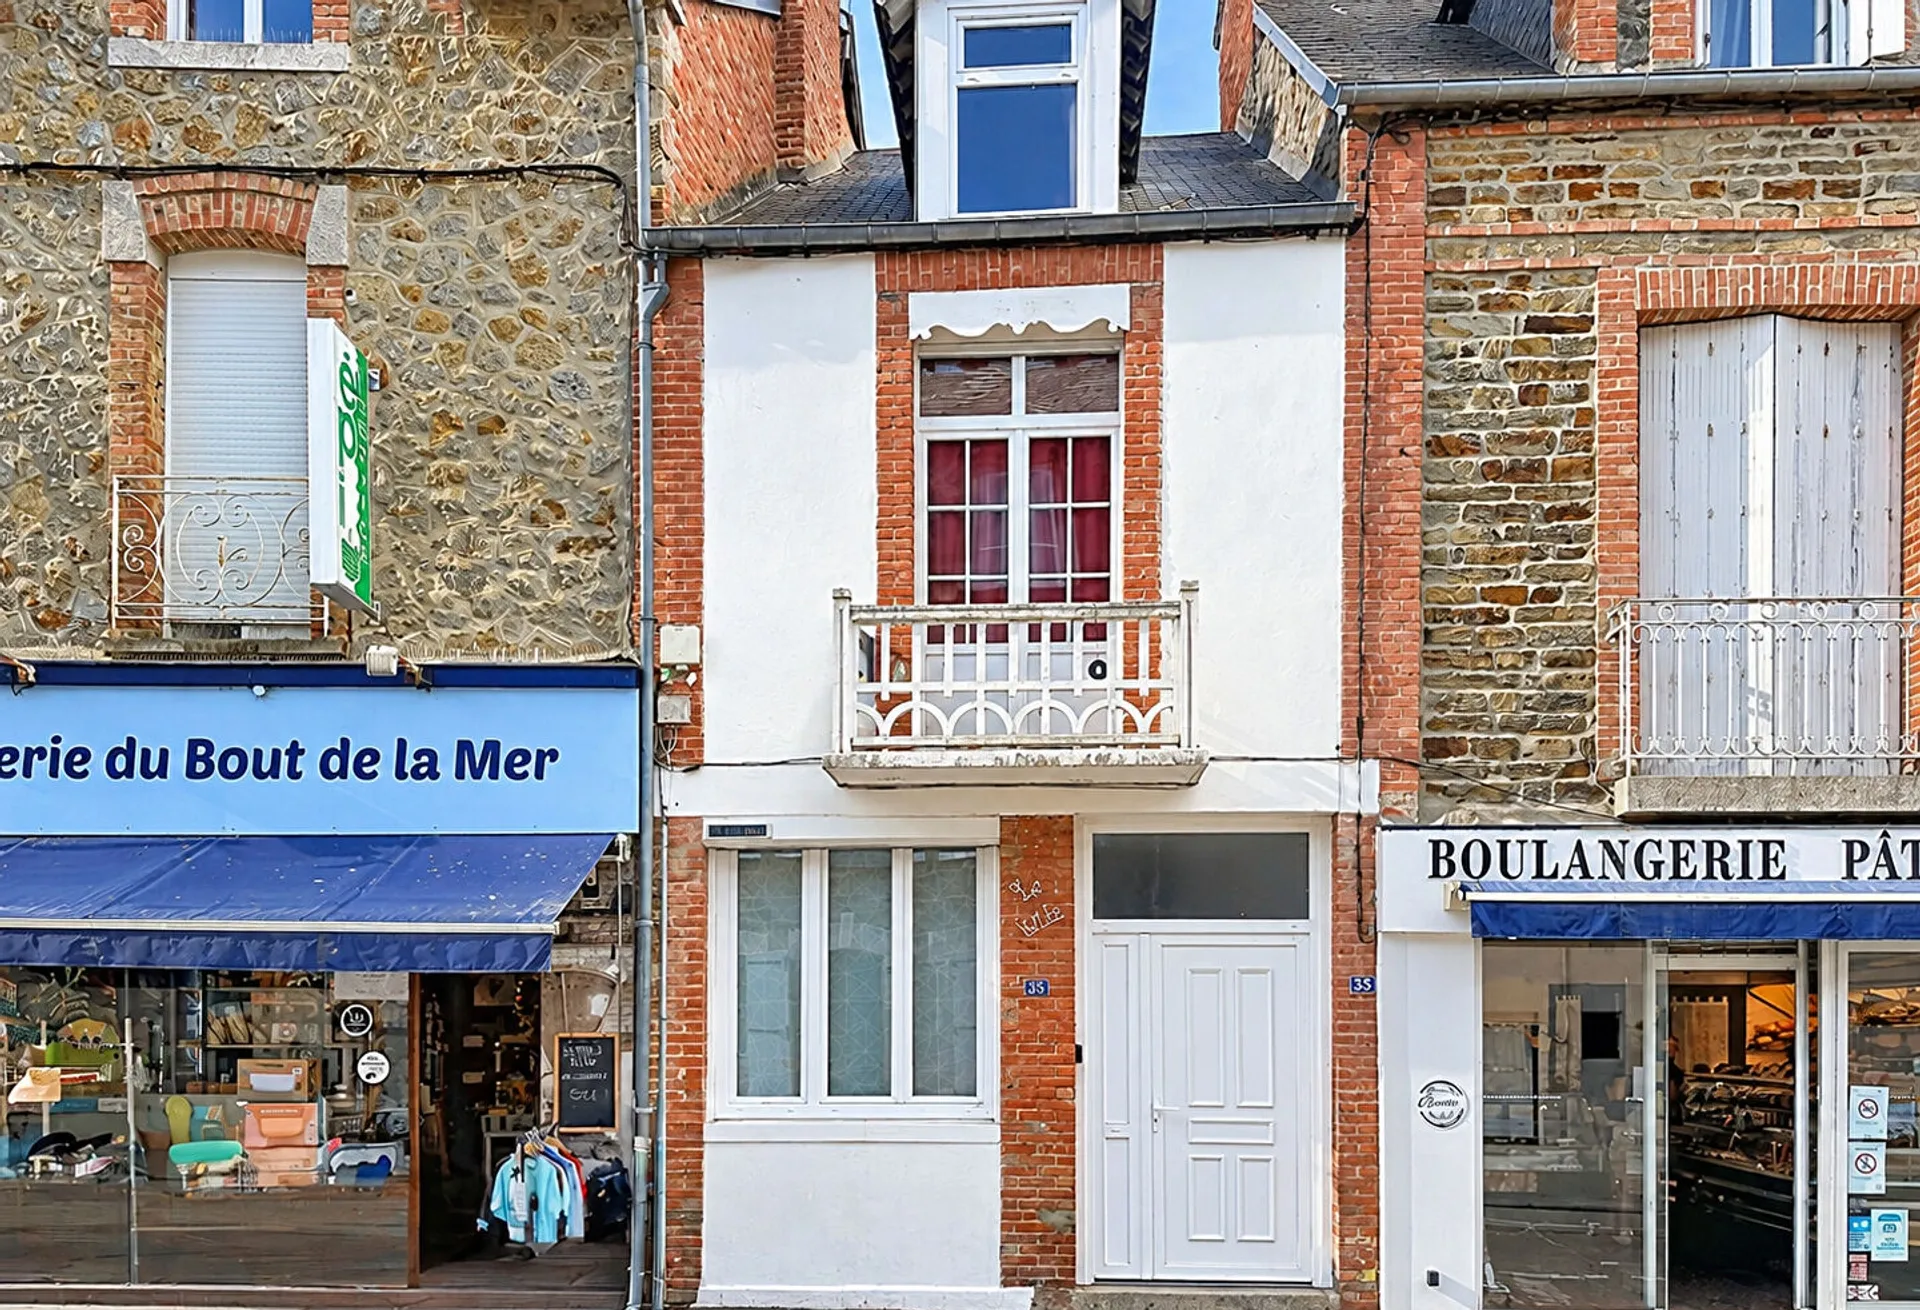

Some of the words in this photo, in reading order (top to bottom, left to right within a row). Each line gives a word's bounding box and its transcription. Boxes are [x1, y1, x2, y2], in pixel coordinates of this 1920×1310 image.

[105, 736, 169, 780] du
[184, 737, 306, 780] Bout
[319, 736, 382, 781] de
[394, 737, 442, 780] la
[454, 738, 560, 780] Mer
[1428, 838, 1787, 881] BOULANGERIE
[1026, 980, 1047, 995] 35
[1352, 977, 1373, 993] 35
